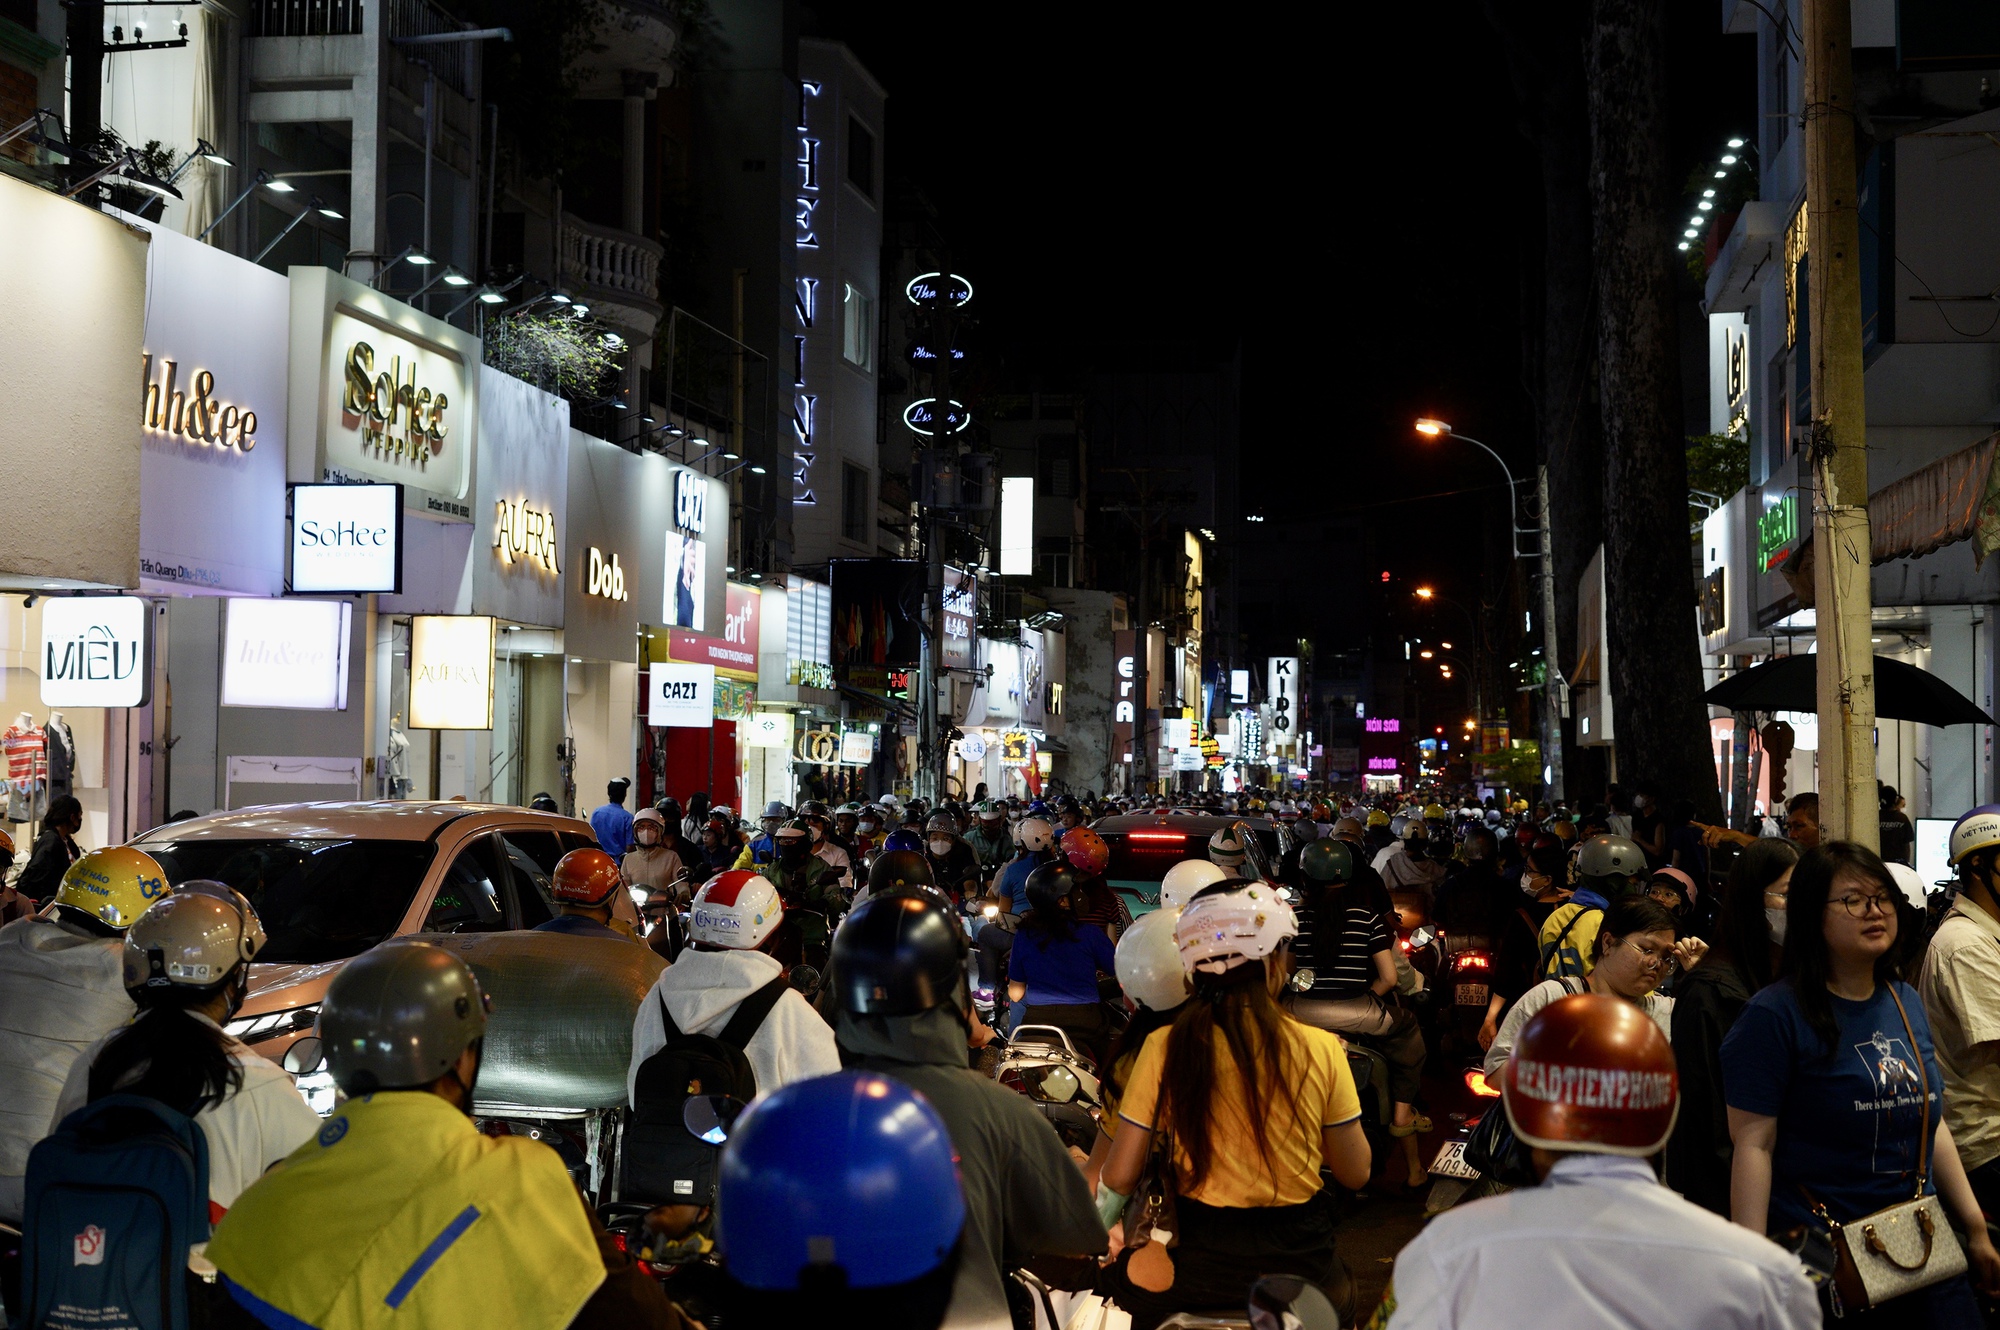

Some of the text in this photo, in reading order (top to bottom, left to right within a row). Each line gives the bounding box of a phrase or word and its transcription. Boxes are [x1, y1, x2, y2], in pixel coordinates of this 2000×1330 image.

[361, 426, 430, 463] WEDDING
[674, 470, 708, 534] CAZI
[301, 521, 388, 547] SoHee
[587, 546, 629, 602] Dob.
[662, 682, 698, 700] CAZI
[140, 742, 152, 756] 96
[136, 875, 162, 899] be
[563, 885, 590, 895] AhaMove
[1461, 985, 1484, 995] 59-U2
[1458, 995, 1486, 1004] 550.20
[1854, 1100, 1873, 1111] There
[1874, 1099, 1880, 1110] is
[1881, 1098, 1896, 1110] hope.
[1444, 1143, 1464, 1158] 76
